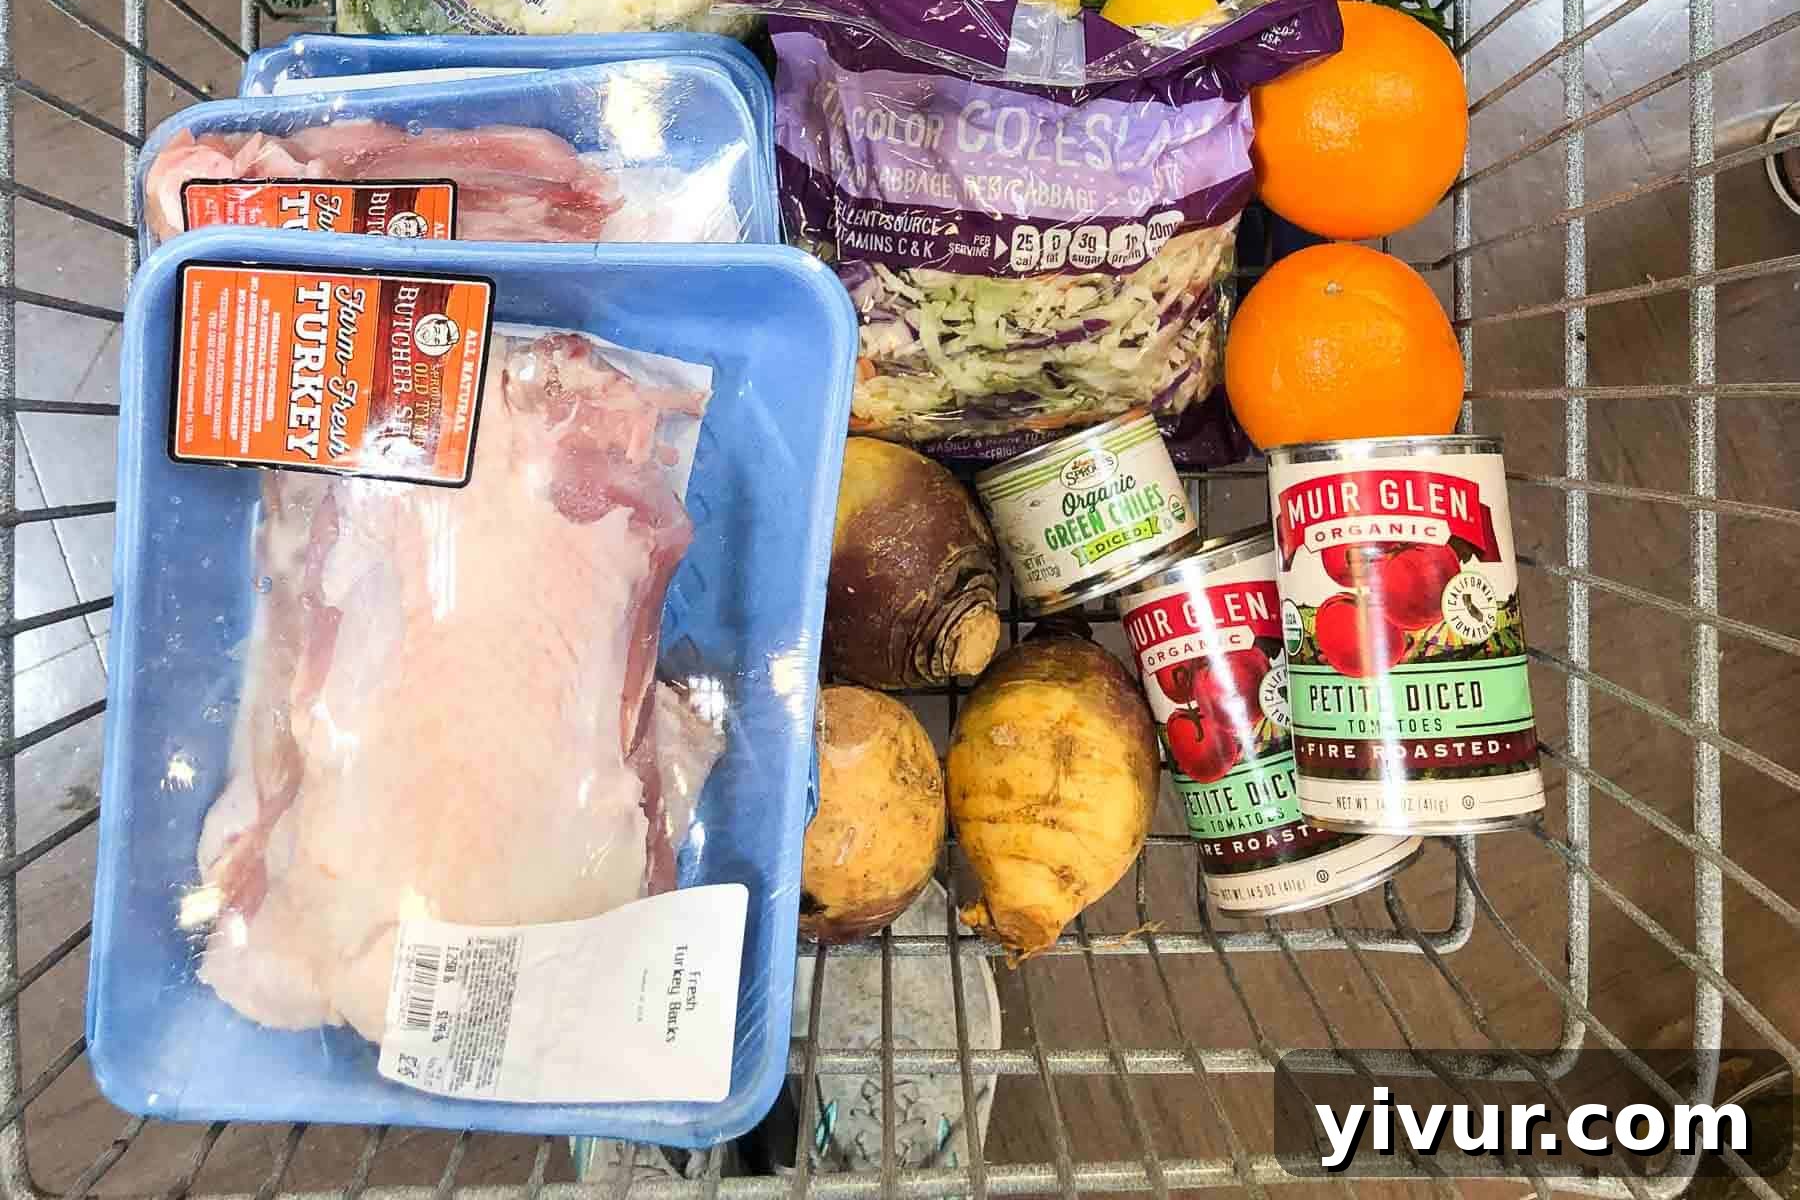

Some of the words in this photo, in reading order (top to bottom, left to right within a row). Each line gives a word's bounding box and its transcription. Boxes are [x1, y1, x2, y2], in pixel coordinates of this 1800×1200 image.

[877, 165, 955, 201] ABBAGE,
[367, 191, 390, 239] BUTC
[886, 213, 941, 237] SOURCE
[835, 224, 894, 254] ITAMINS
[897, 239, 907, 255] C
[911, 240, 921, 257] &
[923, 241, 935, 259] K
[1016, 233, 1034, 252] 25
[1078, 232, 1097, 252] 3g
[1072, 253, 1103, 266] sugar
[391, 286, 420, 395] BUTCHER
[463, 329, 479, 357] ALL
[286, 281, 332, 460] TURKEY
[327, 285, 366, 459] Farm-Fresh
[414, 362, 428, 394] OLD
[455, 361, 475, 433] NATURAL
[1064, 455, 1116, 487] SPROS
[1061, 473, 1136, 517] Organic
[1286, 480, 1359, 529] MUIR
[1380, 478, 1471, 517] GLEN
[1044, 511, 1106, 551] GREEN
[1109, 482, 1165, 526] CHILES
[1314, 522, 1438, 544] ORGANIC
[1095, 525, 1142, 554] DICED
[1448, 576, 1494, 607] CALIFORNIA
[1450, 612, 1496, 639] TOMATOES
[1309, 682, 1393, 714] PETIT
[1407, 679, 1484, 712] DICED
[1348, 717, 1443, 735] TOMTOES
[1307, 743, 1357, 760] FIRE
[1372, 740, 1499, 762] ROASTED
[1233, 824, 1322, 853] ROAST
[667, 943, 689, 995] Turkey
[685, 971, 701, 1012] Fresh
[664, 1002, 682, 1044] Backs
